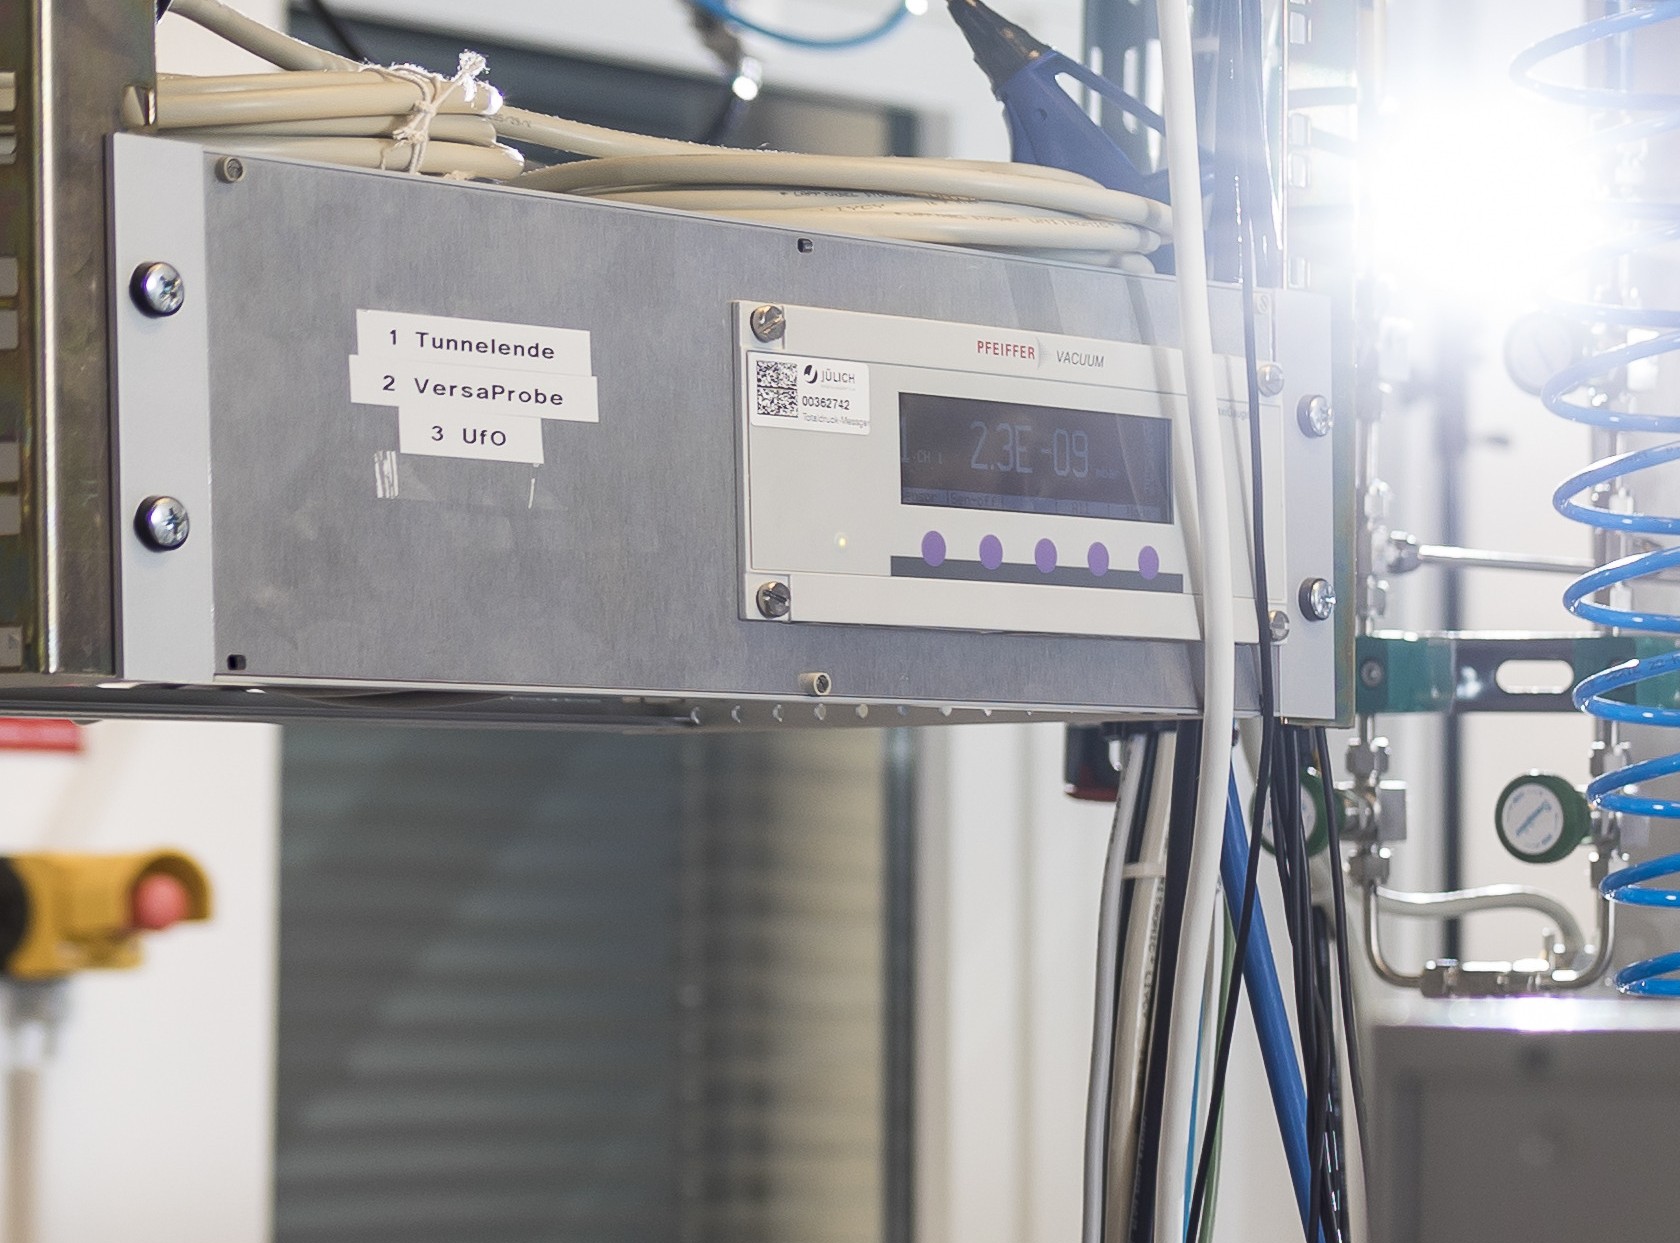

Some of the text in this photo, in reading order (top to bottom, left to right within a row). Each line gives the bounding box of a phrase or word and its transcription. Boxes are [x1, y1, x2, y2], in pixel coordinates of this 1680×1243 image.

[389, 329, 556, 360] 1 Tunnelende
[976, 340, 1105, 368] PFEIFFER VACUUM
[382, 374, 564, 407] 2 VersaProbe
[801, 394, 851, 412] 00362742
[430, 425, 507, 446] 3 UfO
